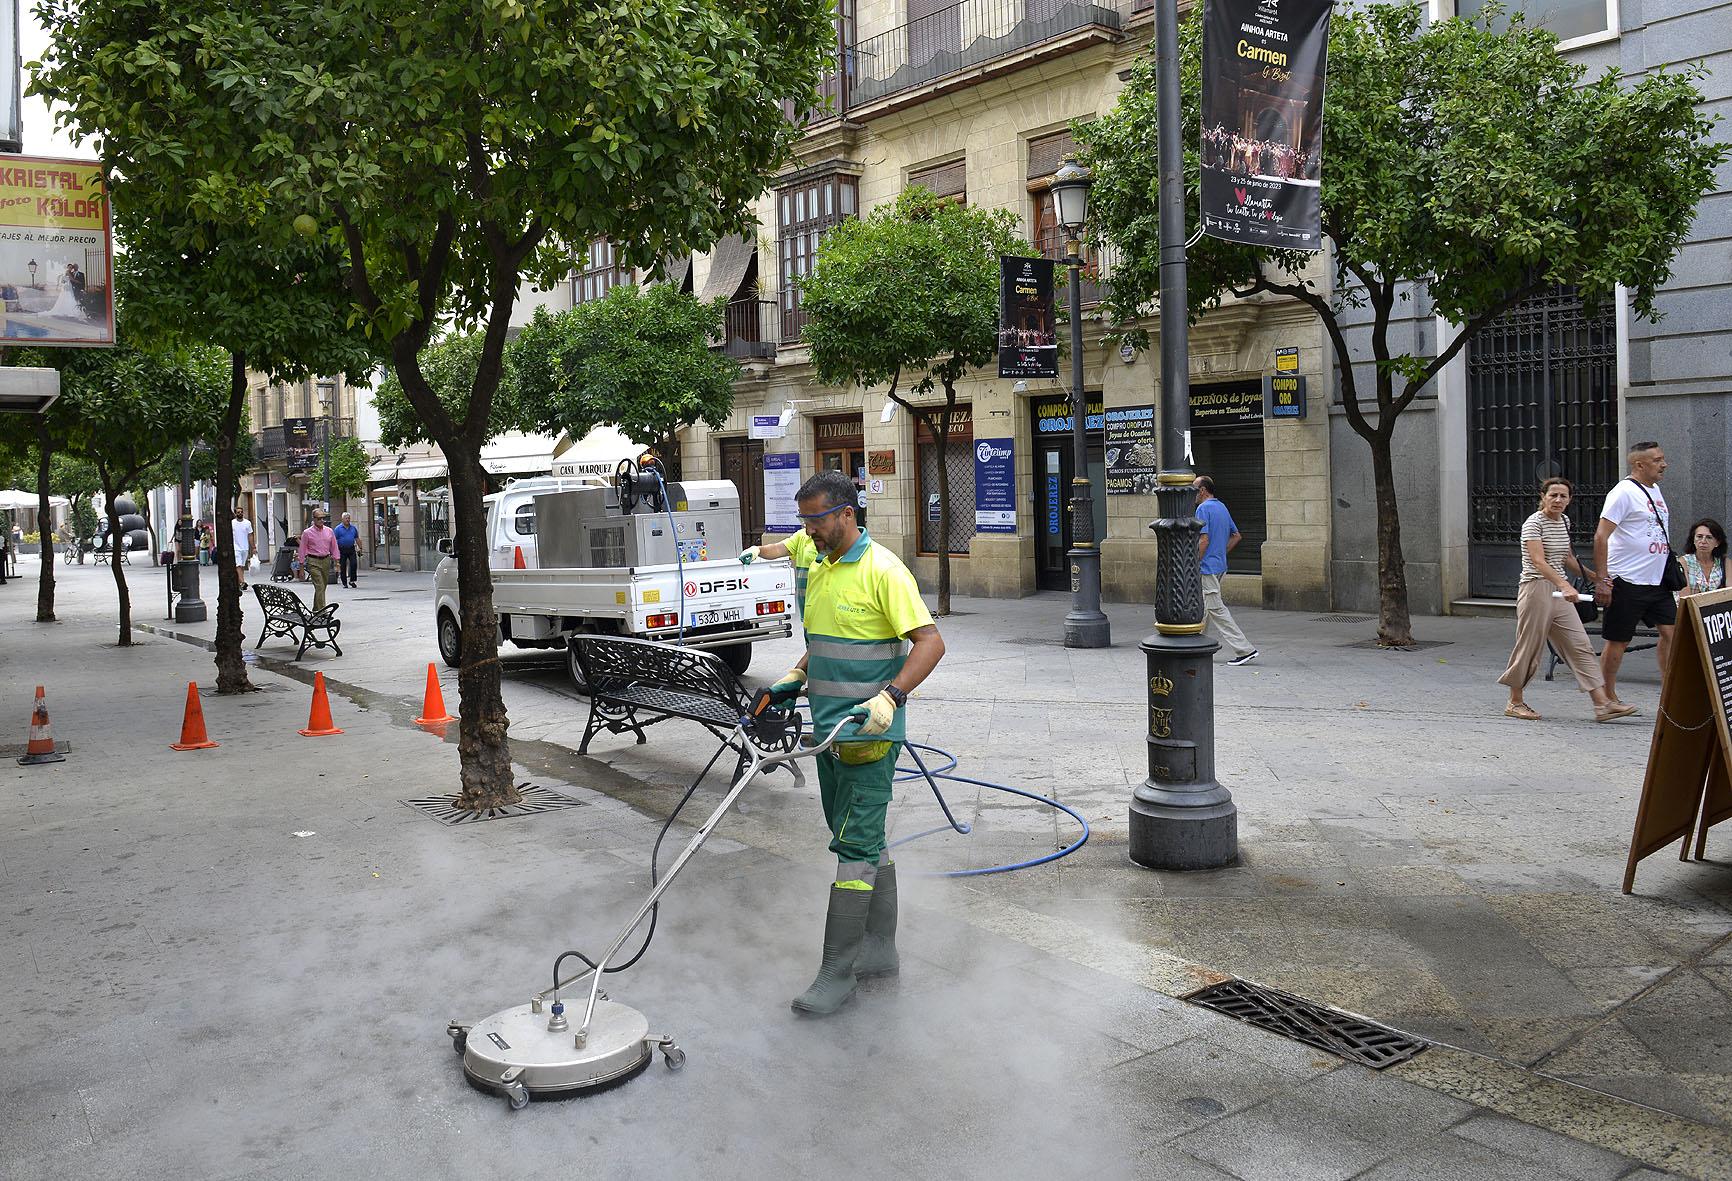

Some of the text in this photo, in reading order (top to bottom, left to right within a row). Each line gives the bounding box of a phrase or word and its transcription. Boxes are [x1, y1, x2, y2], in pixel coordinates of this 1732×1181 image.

[1240, 22, 1288, 42] AINHOA ARTETA
[1237, 39, 1287, 66] Carmen
[0, 167, 83, 191] KRISTAL
[1269, 182, 1282, 190] 2023
[0, 196, 99, 218] foto KOLOR
[24, 233, 34, 241] AL
[38, 234, 65, 242] MEJOR
[68, 236, 97, 244] PRECIO
[1015, 285, 1037, 294] Carmen
[1273, 379, 1297, 390] COMPRO
[1189, 392, 1263, 406] MPEÑOS de Joyas
[1279, 393, 1291, 404] ORO
[1038, 403, 1068, 417] COMPRO
[1106, 409, 1154, 421] OROJEREZ
[1106, 422, 1126, 430] COMPRO
[1109, 431, 1122, 440] Joyas
[1130, 429, 1151, 438] Ocasión
[560, 463, 612, 475] CASA MARQUEZ
[1106, 478, 1132, 487] PAGAMOS
[1048, 476, 1059, 535] OROJEREZ
[1648, 542, 1670, 554] OVE
[700, 578, 749, 594] DFSK
[698, 609, 741, 625] 5320 MHH
